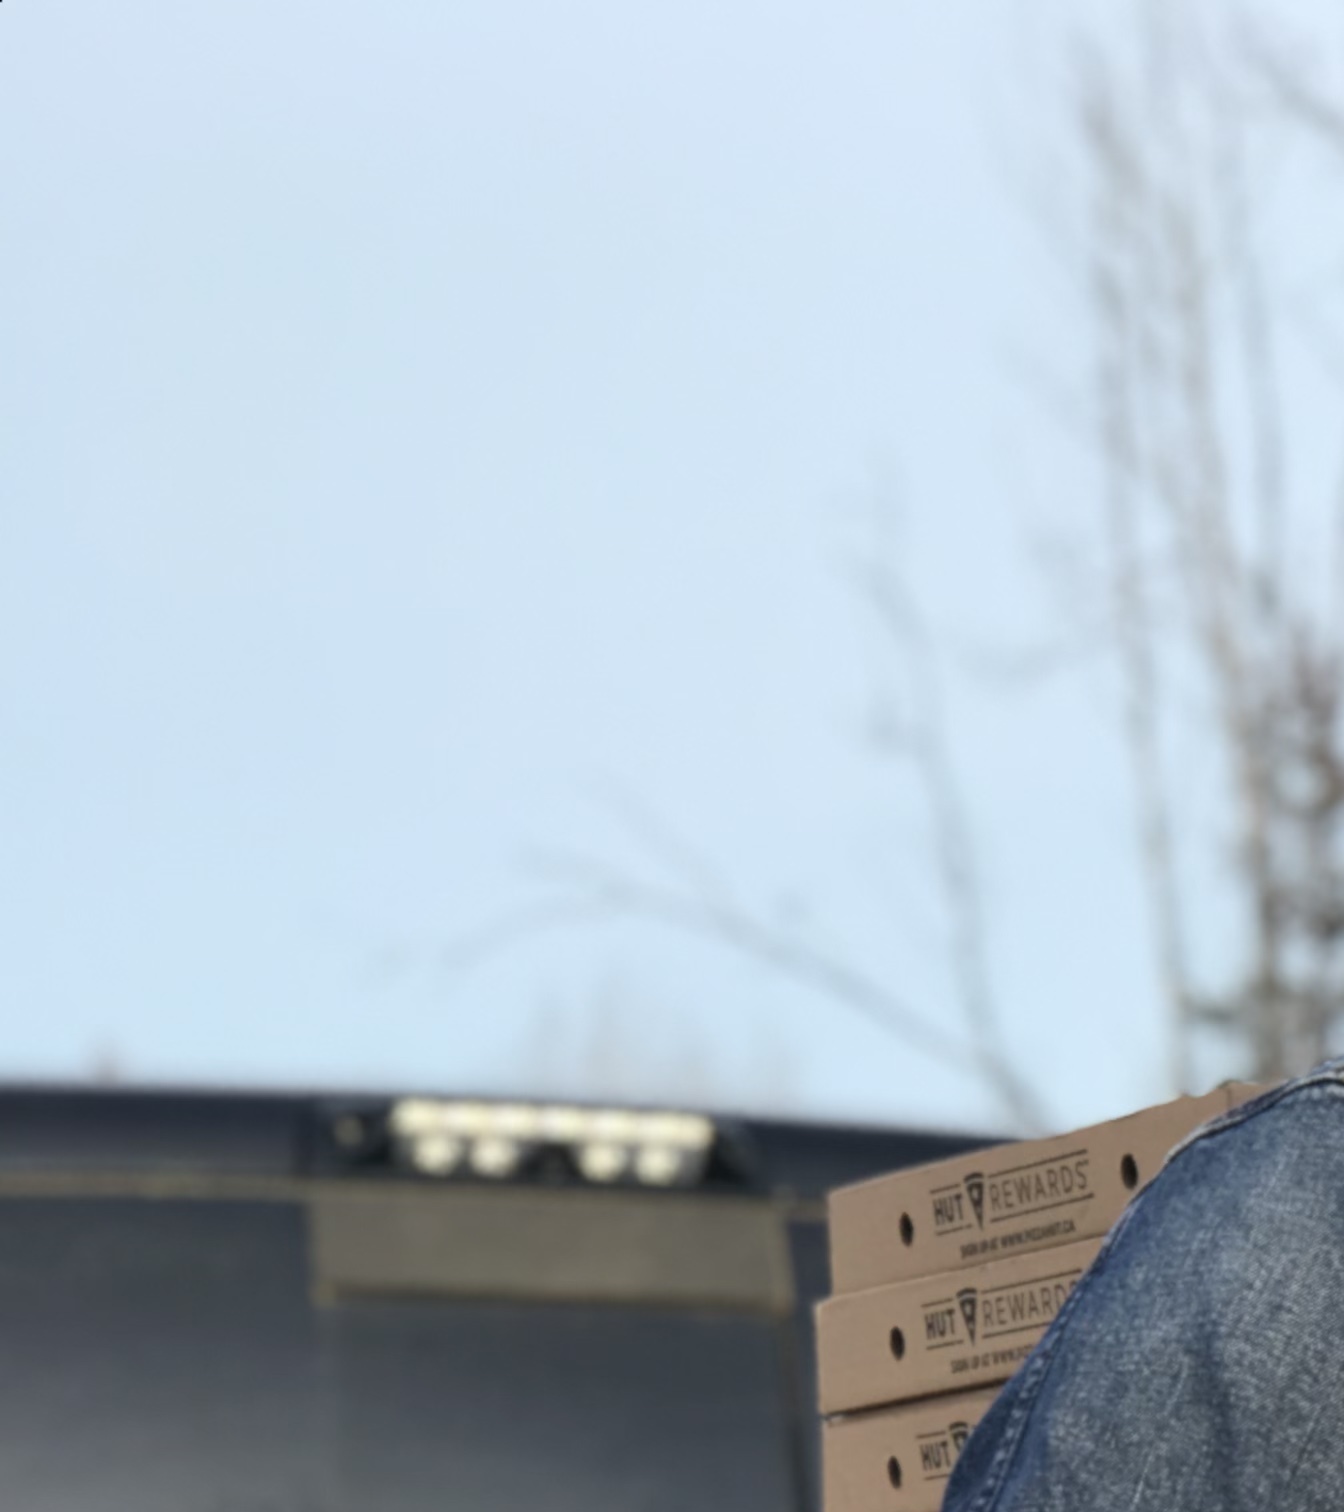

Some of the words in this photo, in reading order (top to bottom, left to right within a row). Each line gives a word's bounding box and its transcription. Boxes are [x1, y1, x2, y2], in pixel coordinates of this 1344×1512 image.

[932, 1192, 964, 1227] HUT
[988, 1162, 1089, 1212] REWARDS
[924, 1308, 955, 1341] HUT
[921, 1440, 951, 1473] HUT
